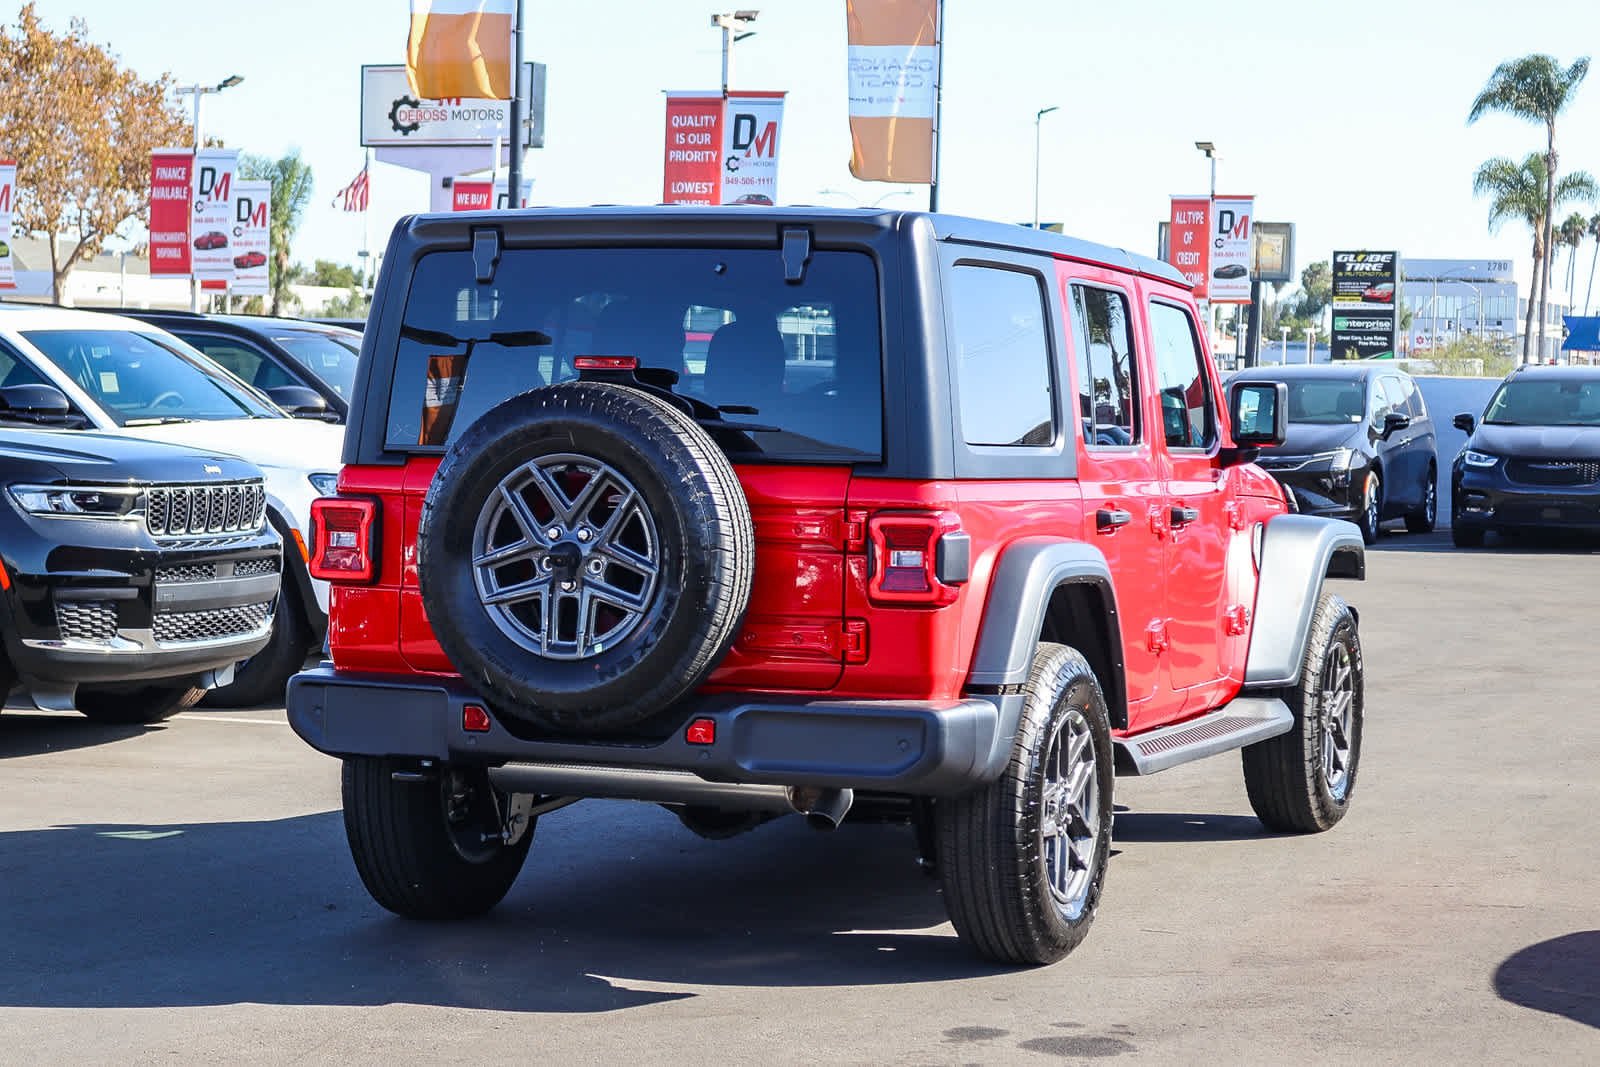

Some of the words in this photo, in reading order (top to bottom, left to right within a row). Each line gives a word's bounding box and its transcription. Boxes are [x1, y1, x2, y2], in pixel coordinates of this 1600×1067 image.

[399, 109, 448, 121] DEBOSS
[451, 108, 504, 121] MOTORS
[672, 115, 717, 127] QUALITY
[676, 133, 686, 144] IS
[688, 133, 711, 145] OUR
[669, 150, 718, 162] PRIORITY
[155, 167, 187, 180] FINANCE
[152, 186, 188, 200] AVAILABLE
[671, 182, 714, 194] LOWEST
[456, 193, 469, 205] WE
[471, 192, 488, 205] BUY
[1175, 211, 1187, 223] ALL
[1187, 211, 1204, 224] TYPE
[1183, 232, 1194, 245] OF
[1176, 252, 1200, 264] CREDIT
[1336, 253, 1393, 263] GLOBE
[1345, 262, 1384, 272] TIRE
[1487, 262, 1508, 271] 2780
[1338, 319, 1391, 329] enterprise
